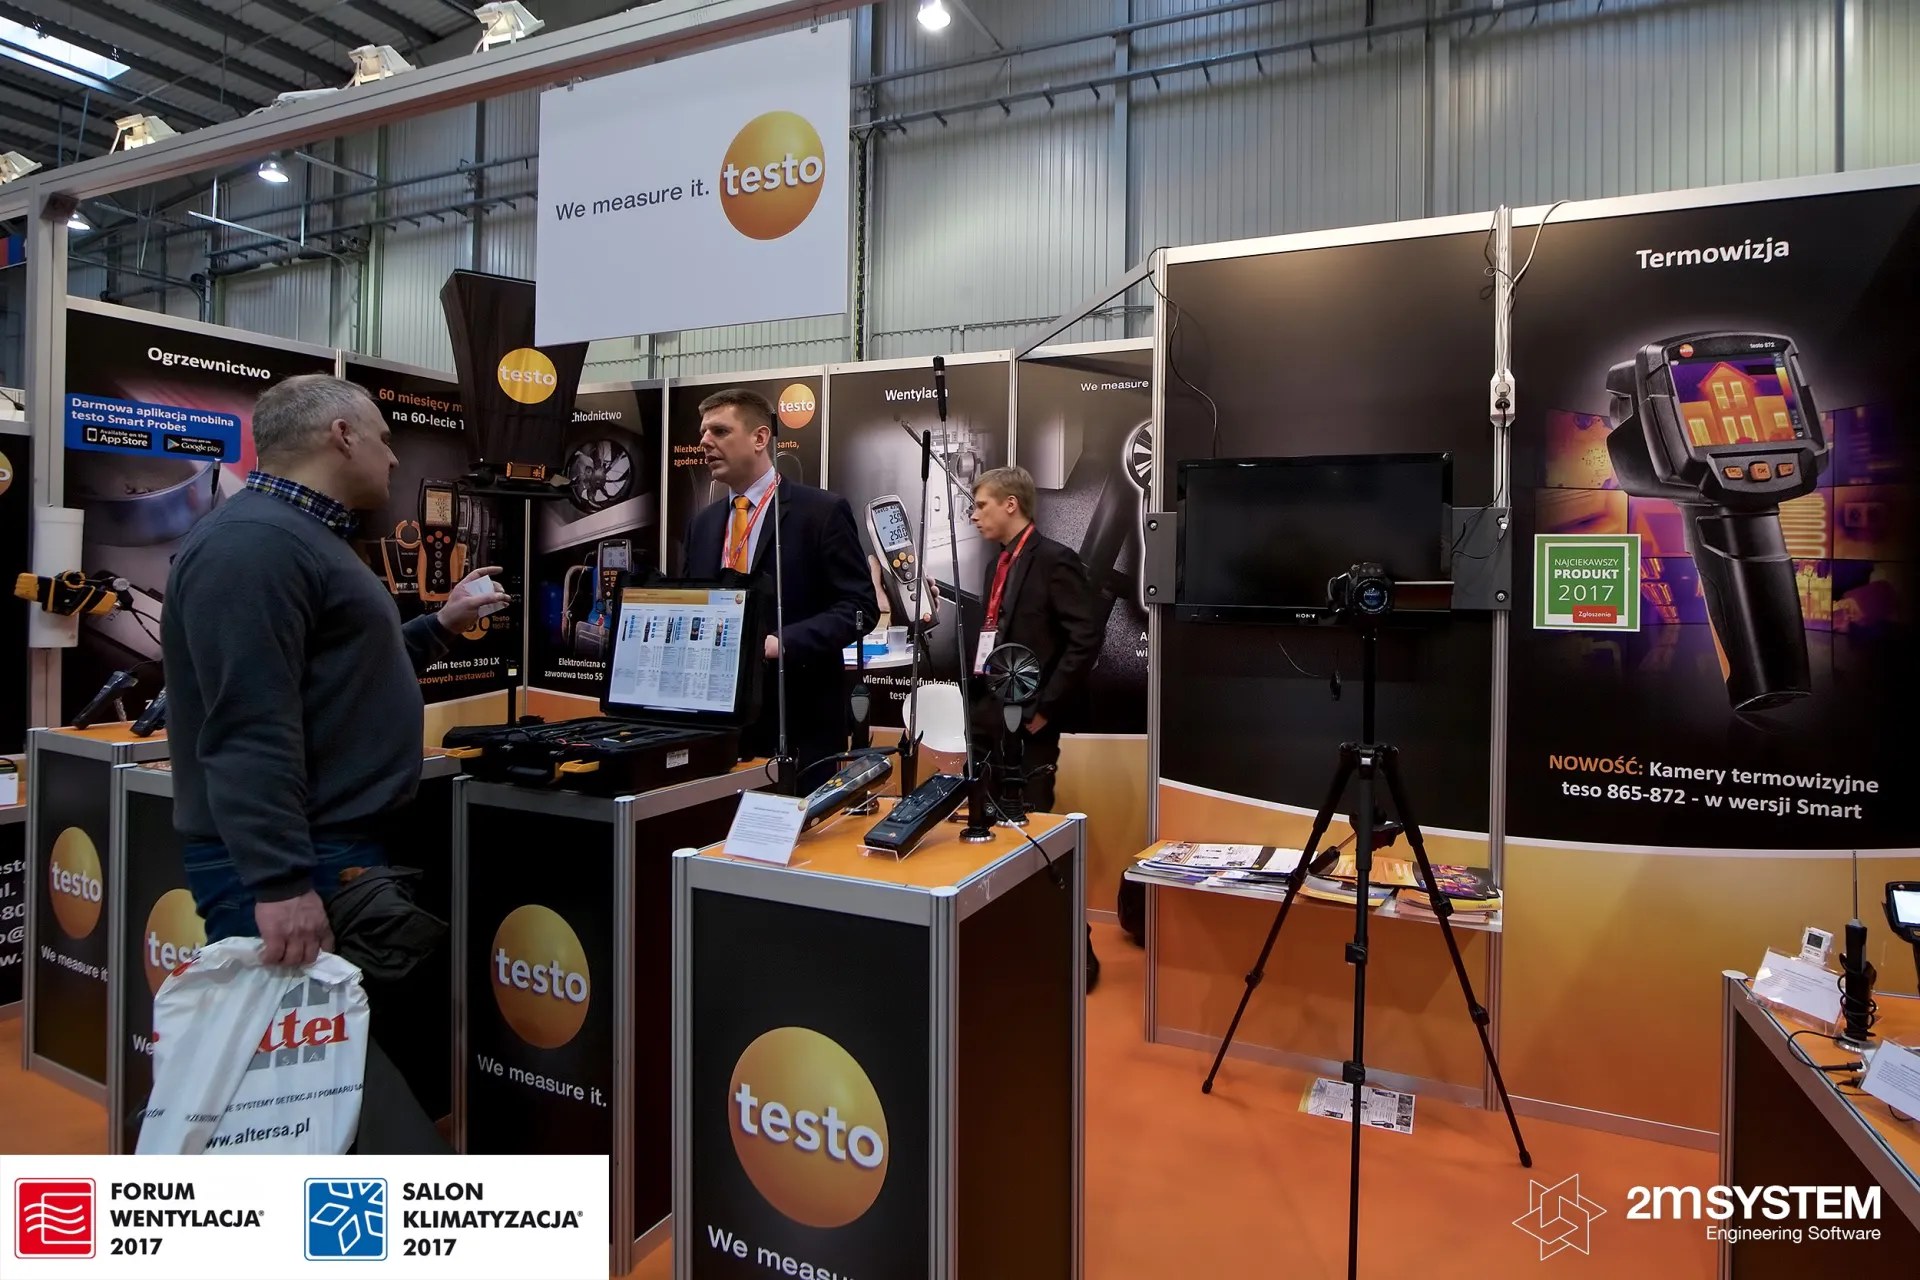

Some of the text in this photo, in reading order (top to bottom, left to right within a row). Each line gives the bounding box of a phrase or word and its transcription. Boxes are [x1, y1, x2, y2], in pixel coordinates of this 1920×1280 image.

[722, 152, 823, 197] testo
[555, 178, 710, 221] We measure it.
[1636, 237, 1790, 270] Termowizja
[147, 347, 271, 380] Ogrzewnictwo
[499, 365, 556, 386] testo
[1080, 379, 1149, 392] We measure
[379, 388, 395, 400] 60
[398, 393, 450, 412] miesięcy
[779, 399, 815, 413] testo
[71, 397, 234, 427] Darmowa aplikacja mobilna
[71, 410, 187, 432] testo Smart Probes
[392, 410, 408, 421] na
[411, 412, 457, 429] 60-lecie
[100, 434, 148, 447] App Store
[181, 441, 221, 453] Google play
[674, 457, 698, 467] zgodne
[1554, 558, 1619, 567] NAJCIEKAWSZY
[1554, 569, 1620, 579] PRODUKT
[1558, 584, 1614, 602] 2017
[450, 660, 471, 669] testo
[473, 658, 488, 667] 330
[488, 657, 500, 666] LX
[558, 657, 601, 668] Elektroniczna
[455, 671, 495, 682] zestawach
[544, 670, 577, 679] zaworowa
[577, 672, 594, 680] testo
[1549, 753, 1879, 796] NOWOŚĆ: Kamery termowizyjne
[1561, 780, 1602, 798] teso
[1606, 783, 1686, 805] 865-872
[1704, 794, 1722, 808] w
[1728, 795, 1791, 817] wersji
[1796, 798, 1863, 820] Smart
[52, 861, 101, 903] testo
[41, 944, 57, 962] We
[57, 954, 100, 978] measure
[495, 948, 588, 1003] testo
[132, 1034, 154, 1056] We
[477, 1054, 608, 1108] We measure it.
[235, 1098, 275, 1111] SYSTEMY
[275, 1092, 313, 1106] DETEKCJI
[318, 1084, 354, 1098] POMIARU
[735, 1082, 884, 1169] testo
[707, 1224, 748, 1259] We
